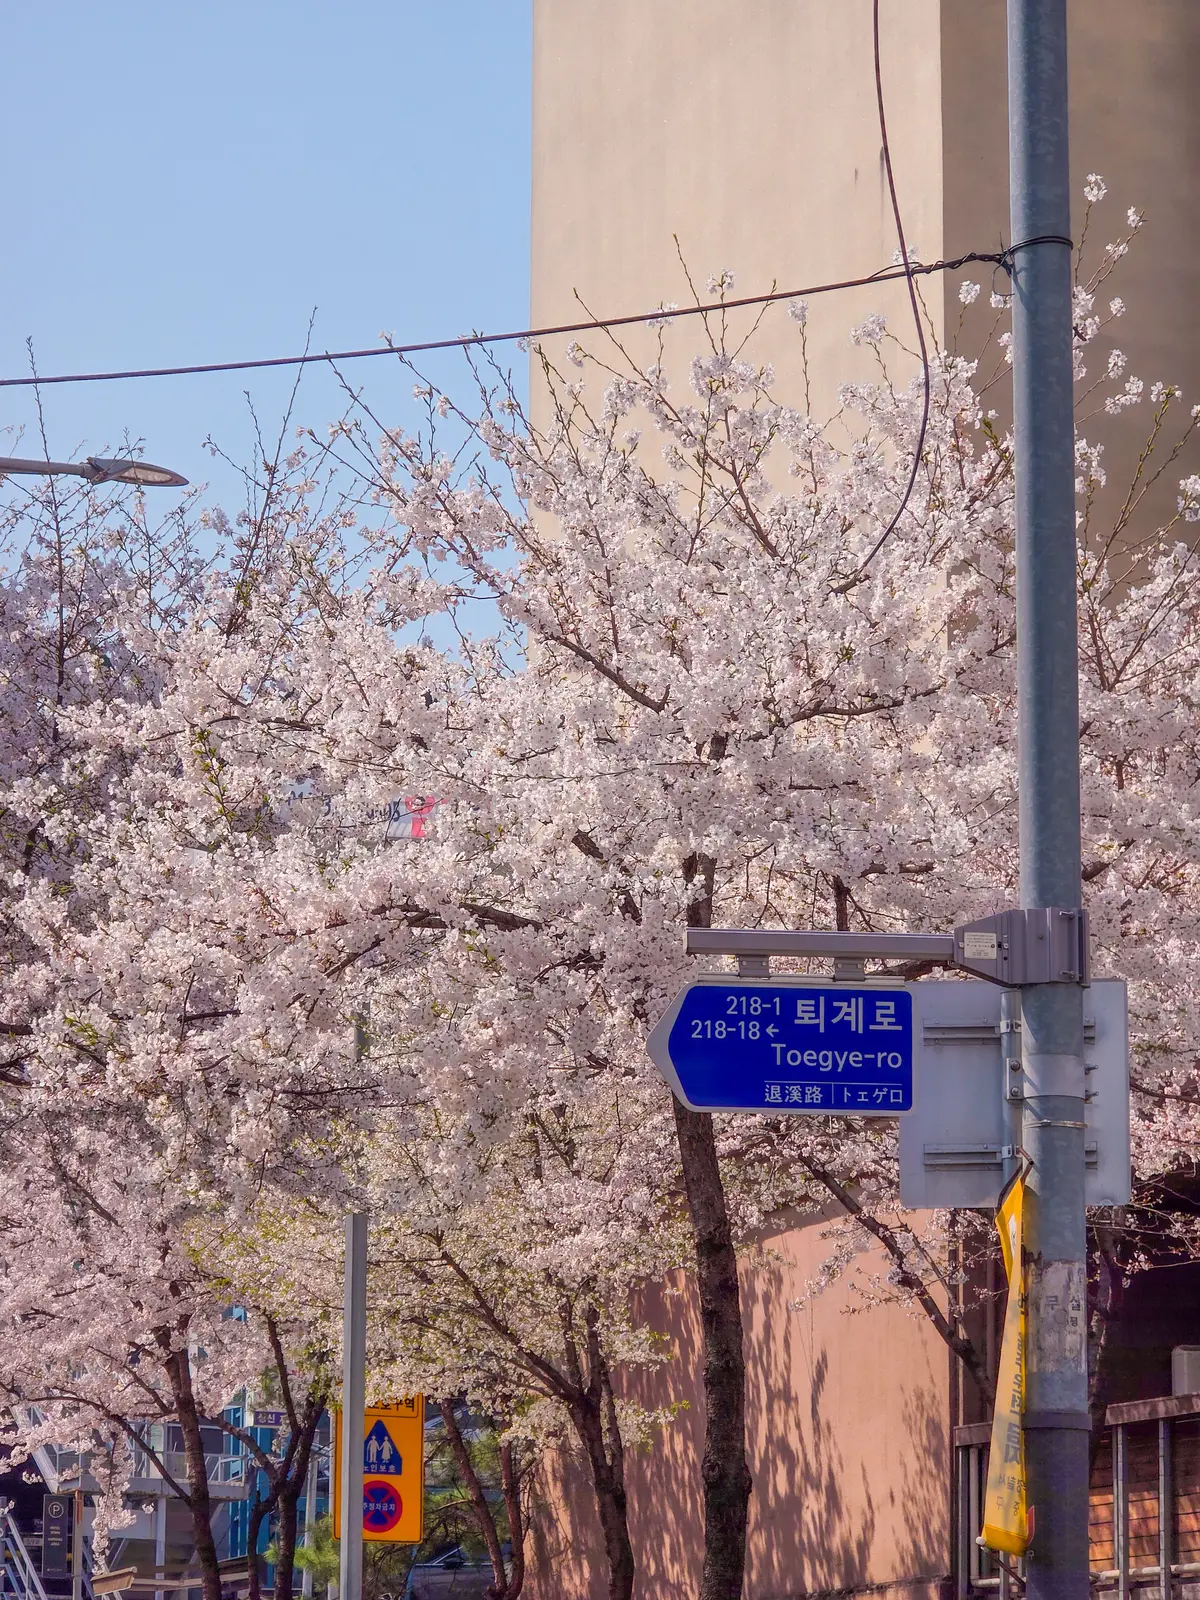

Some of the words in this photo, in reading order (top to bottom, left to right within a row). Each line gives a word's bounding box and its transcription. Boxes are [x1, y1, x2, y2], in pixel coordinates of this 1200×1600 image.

[727, 996, 780, 1015] 218-1
[794, 996, 902, 1033] 퇴계로
[691, 1020, 760, 1039] 218-18
[771, 1044, 902, 1072] Toegye-ro
[764, 1085, 823, 1103] 退溪路
